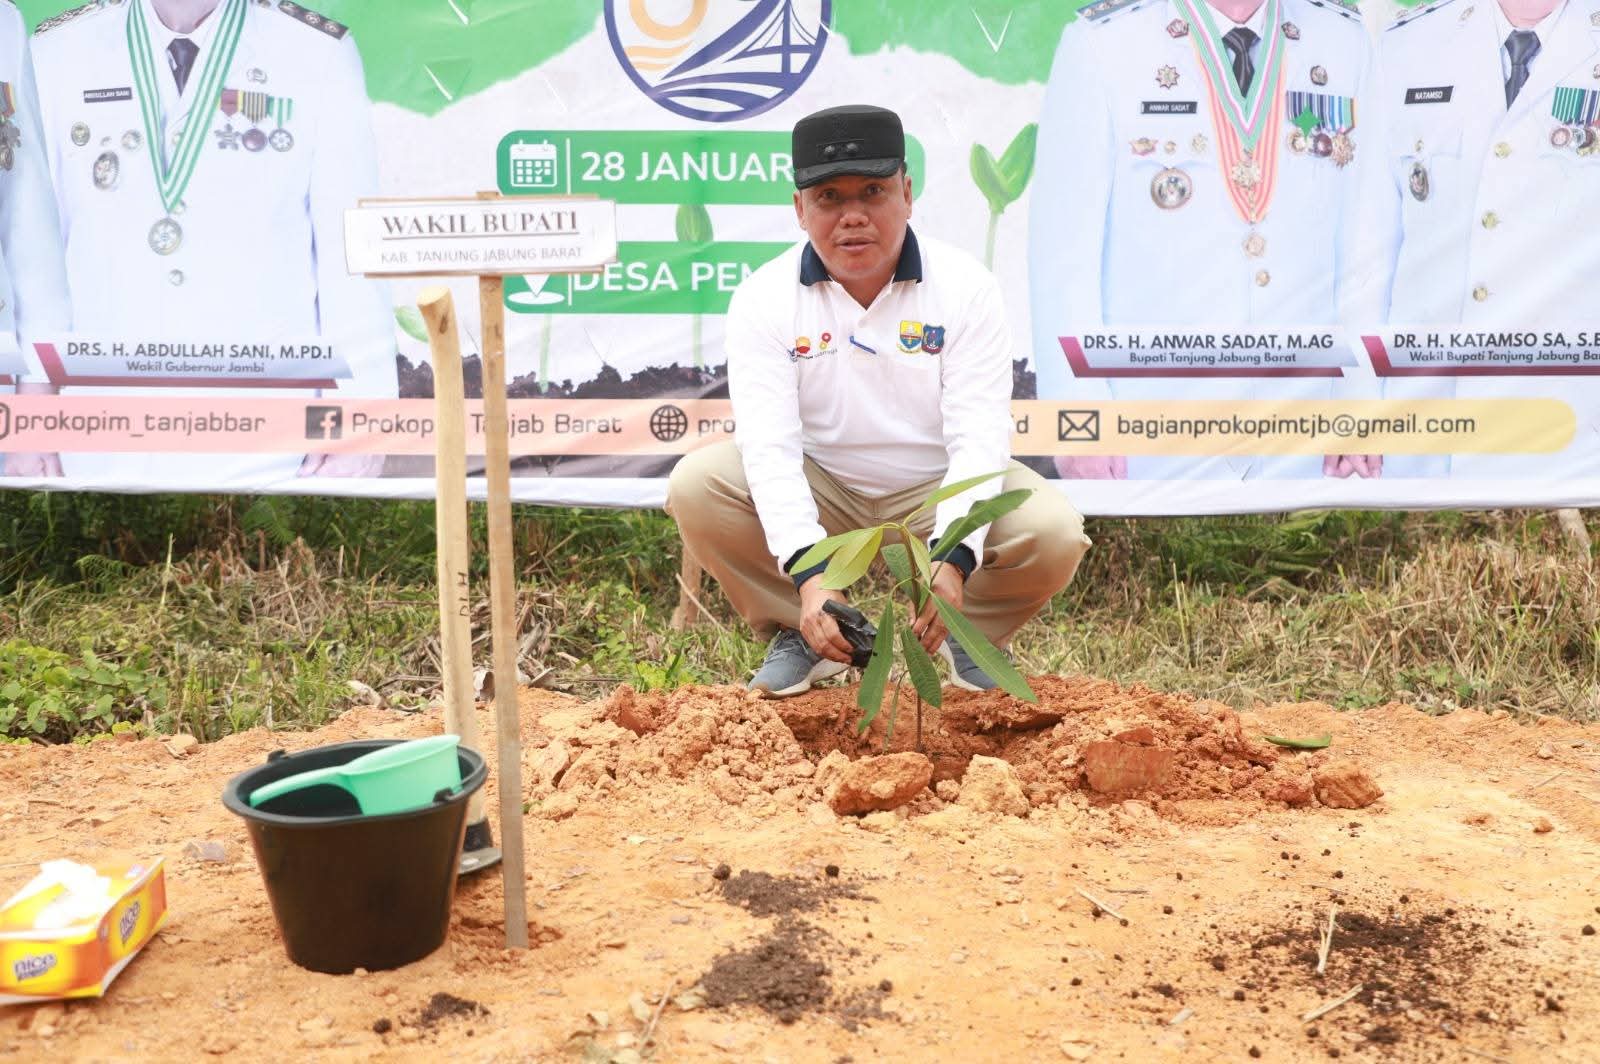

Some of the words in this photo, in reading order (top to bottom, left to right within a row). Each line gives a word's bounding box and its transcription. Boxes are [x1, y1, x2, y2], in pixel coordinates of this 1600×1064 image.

[581, 151, 626, 182] 28
[635, 151, 795, 182] JANUAR
[382, 214, 476, 235] WAKIL
[483, 211, 577, 233] BUPATI
[416, 250, 479, 263] TANJUNG
[482, 248, 537, 263] JABUNG
[541, 247, 582, 259] BARAT
[573, 261, 679, 292] DESA
[1083, 334, 1123, 349] DRS.
[1128, 335, 1146, 349] H.
[1151, 334, 1216, 349] ANWAR
[1222, 334, 1282, 351] SADAT,
[1286, 334, 1334, 349] M.AG
[1394, 334, 1421, 349] DR.
[1427, 333, 1445, 348] H.
[1450, 332, 1538, 348] KATAMSO
[1542, 332, 1571, 350] SA,
[67, 342, 107, 357] DRS.
[112, 343, 130, 357] H.
[134, 343, 225, 358] ABDULLAH
[229, 344, 275, 360] SANI,
[279, 345, 333, 360] M.PD.I
[1129, 352, 1167, 363] Bupati
[1170, 352, 1214, 365] Tanjung
[1217, 352, 1261, 365] Jabung
[1264, 352, 1297, 363] Barat
[1410, 351, 1443, 362] Wakil
[1447, 350, 1486, 363] Bupati
[1488, 350, 1534, 363] Tanjung
[1536, 350, 1580, 363] Jabung
[1583, 350, 1600, 361] Ba
[127, 361, 162, 372] Wakil
[165, 361, 224, 373] Gubernur
[228, 362, 265, 373] Jambi
[15, 411, 266, 438] prokopim_tanjabbar
[352, 413, 434, 439] Prokop
[470, 413, 545, 438] Tjab
[554, 414, 622, 434] Barat
[698, 419, 736, 438] pro
[1118, 414, 1475, 439] bagianprokopimtjb@gmail.com
